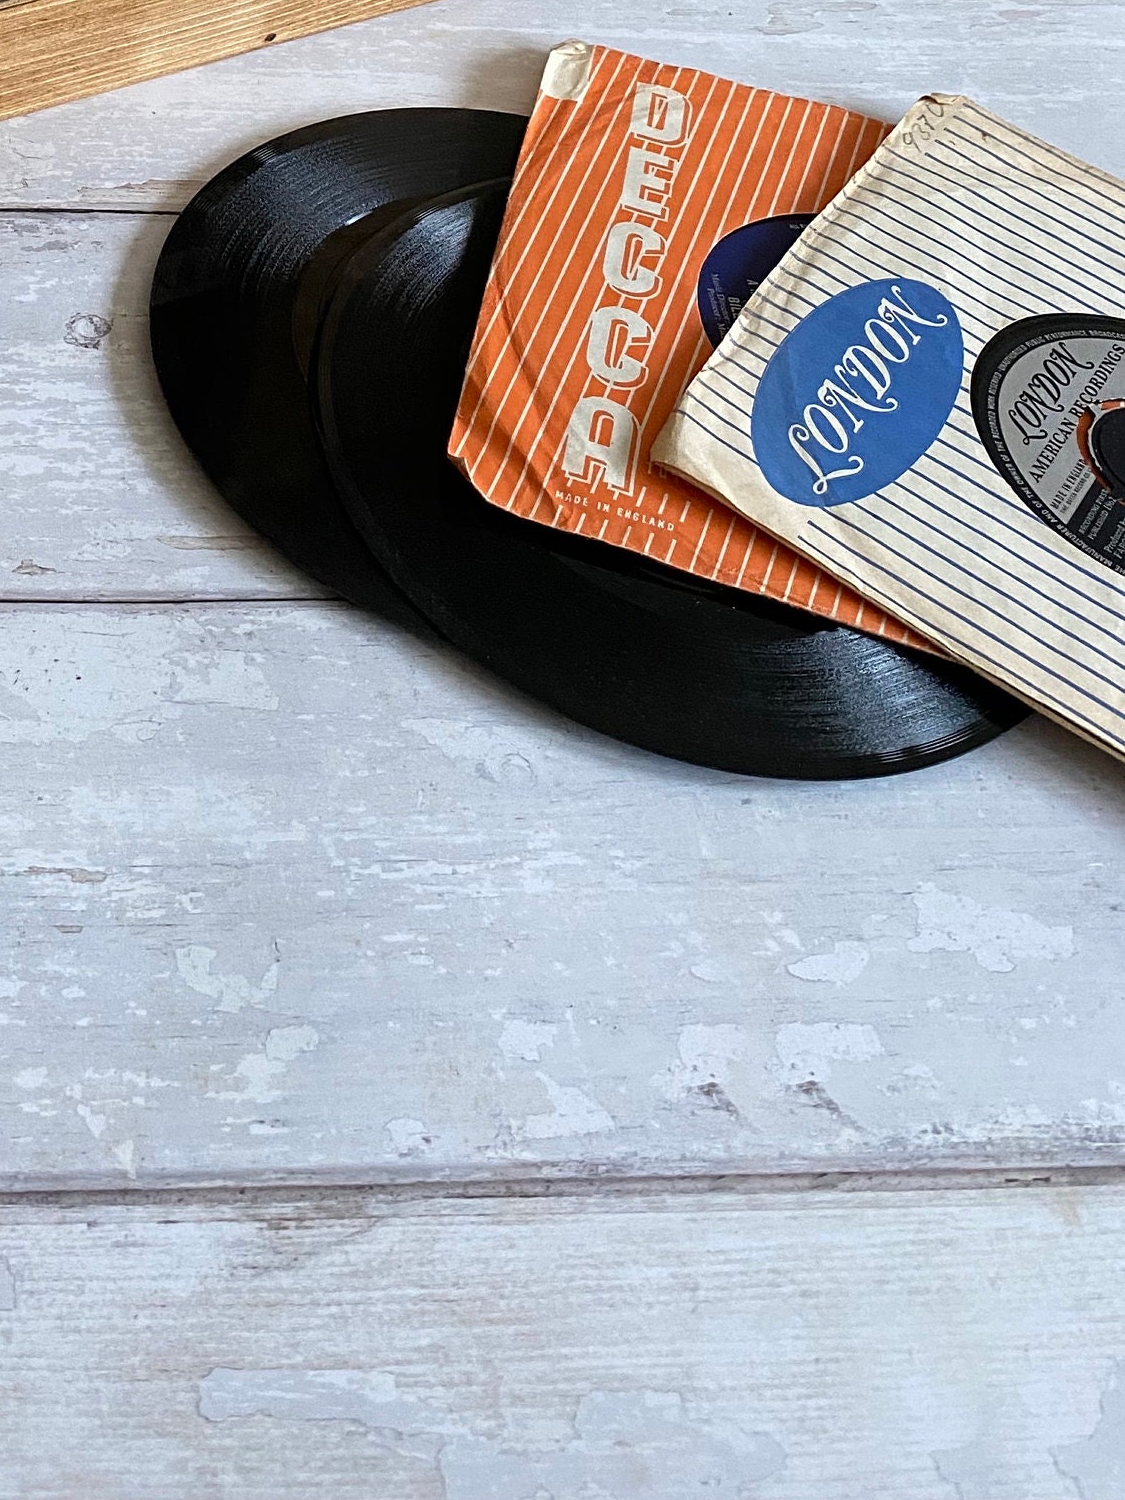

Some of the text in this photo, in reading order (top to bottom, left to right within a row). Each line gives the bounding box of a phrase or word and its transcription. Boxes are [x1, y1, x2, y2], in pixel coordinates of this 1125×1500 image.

[561, 80, 693, 497] DECCA
[787, 284, 949, 494] LONDON
[988, 371, 1002, 395] RESERVED
[1008, 341, 1095, 446] LONDON
[987, 394, 996, 410] WORK
[1028, 343, 1125, 483] AMERICAN RECORDINGS
[987, 410, 1000, 439] RECORDED
[994, 440, 1006, 454] THE
[1000, 453, 1010, 462] OF
[1005, 462, 1024, 485] OWNER
[1049, 458, 1087, 510] MADE IN ENGLAND
[1021, 486, 1034, 499] THE
[1032, 500, 1042, 508] OF
[555, 490, 675, 532] MADE IN ENGLAND
[1041, 508, 1058, 523] AND
[1078, 503, 1100, 534] RECORDING
[1087, 509, 1109, 540] PUBLISHED
[1056, 523, 1113, 567] MANUFACTURER
